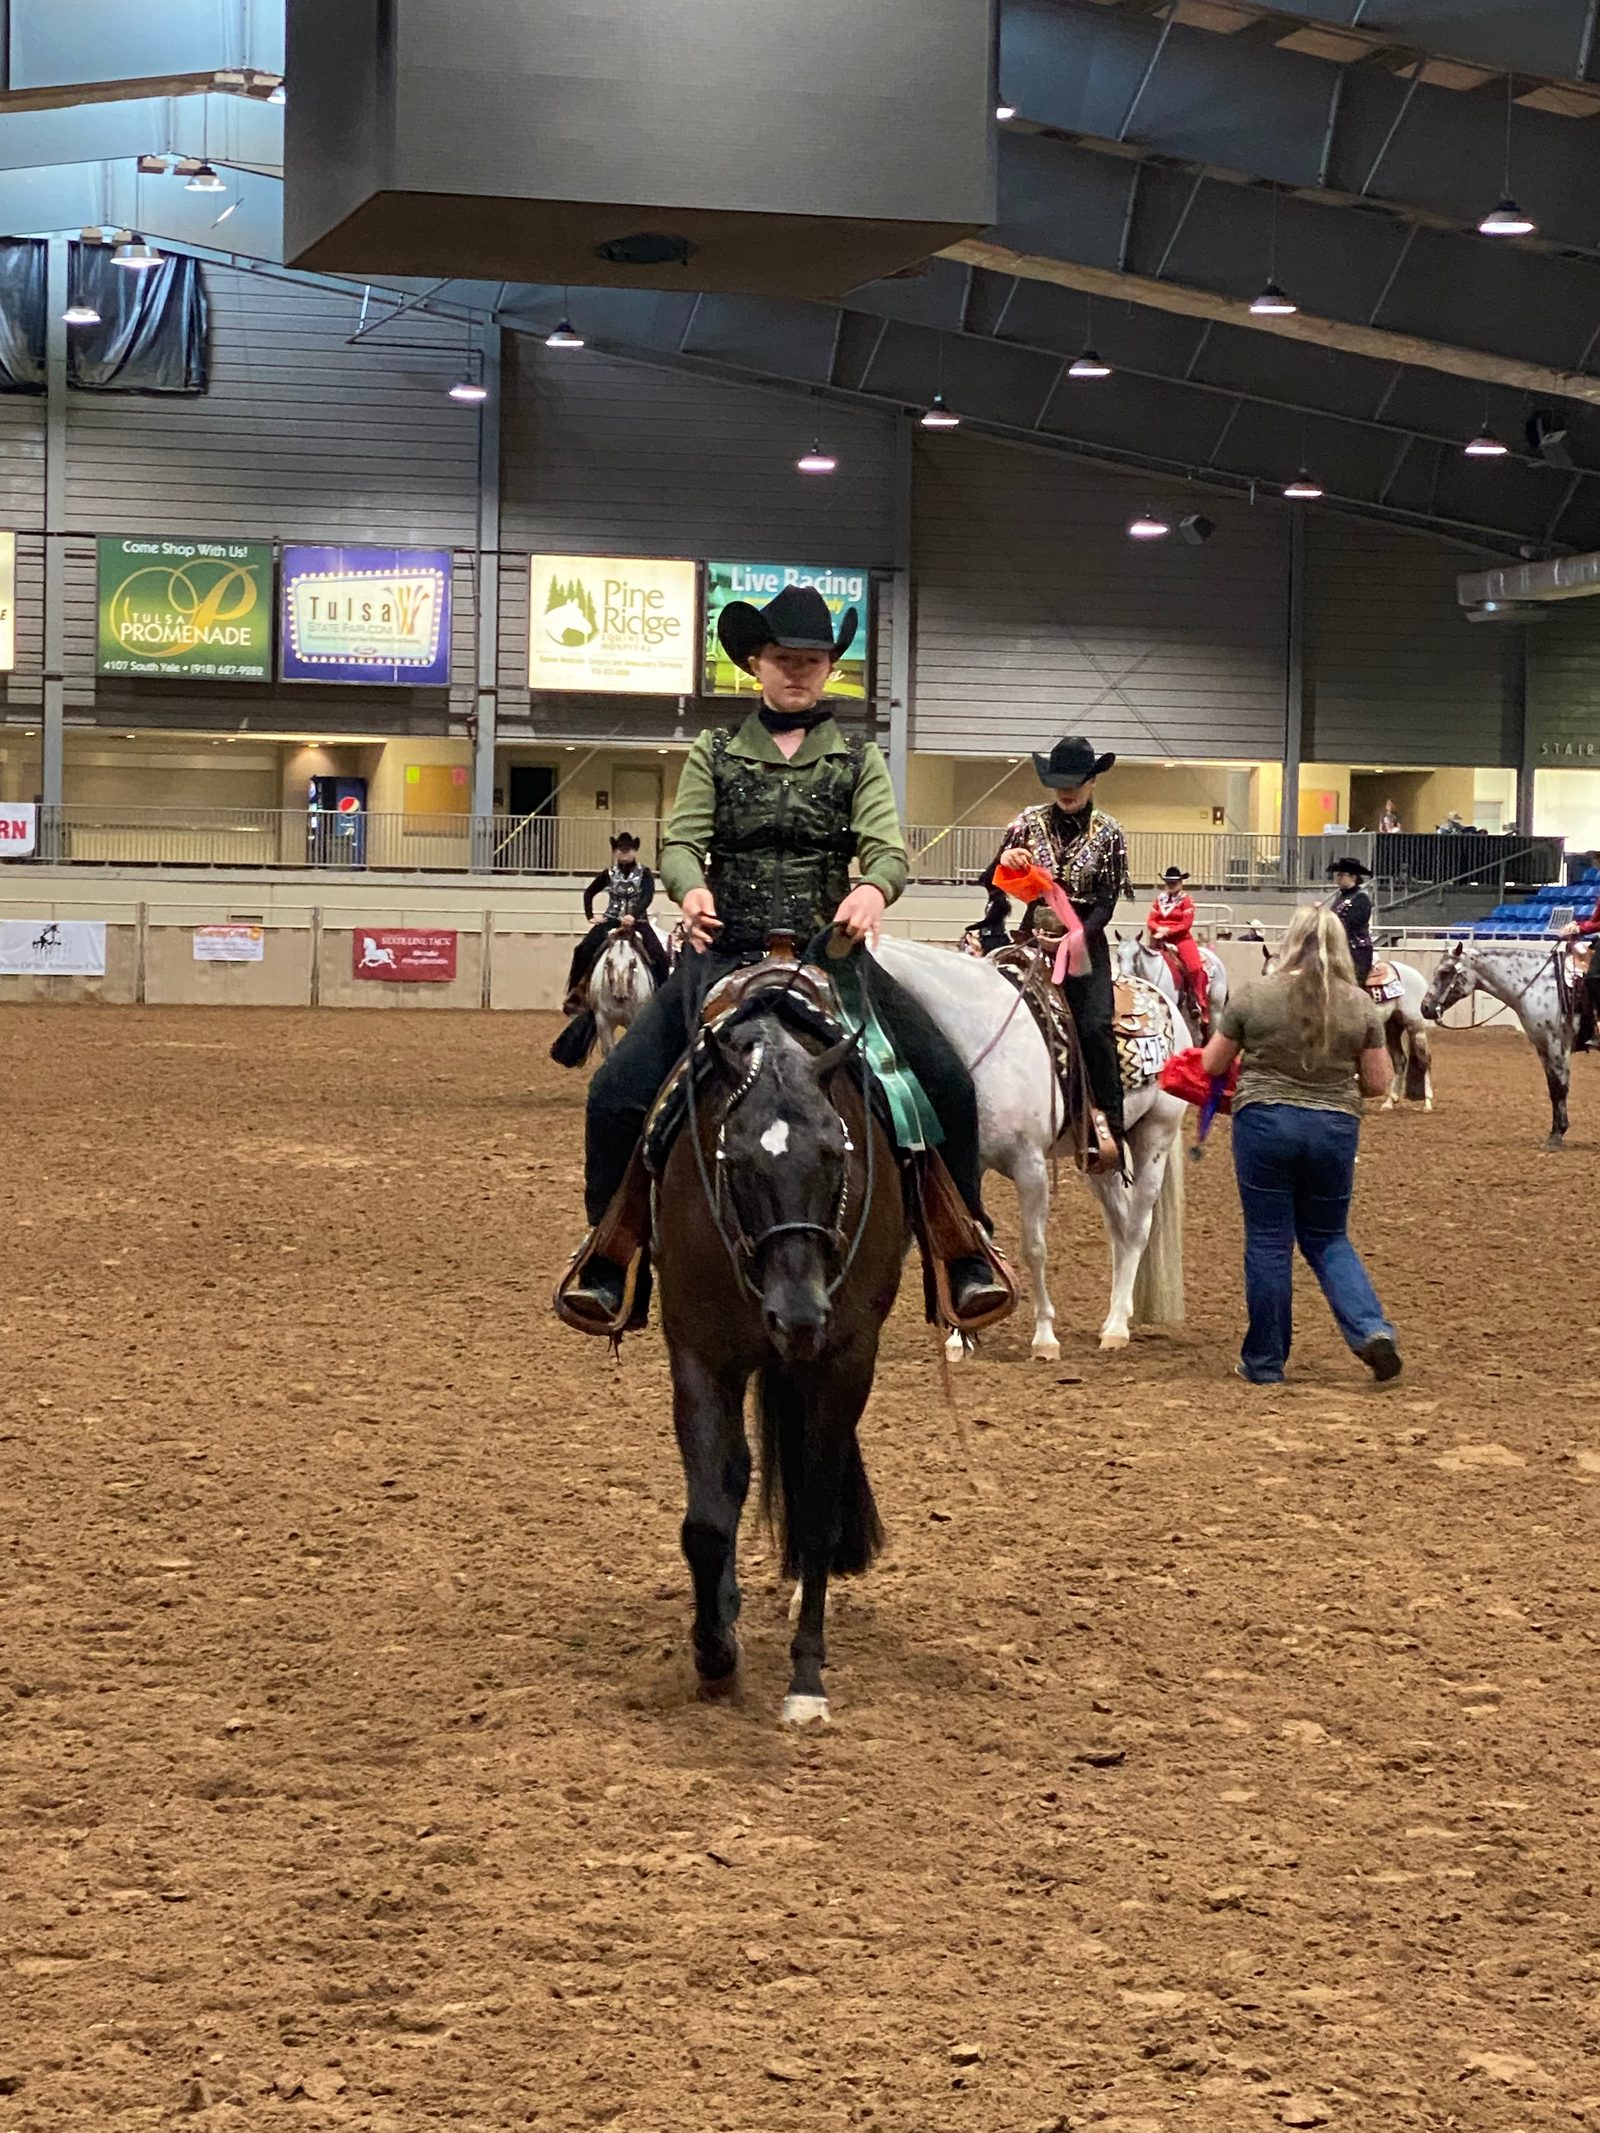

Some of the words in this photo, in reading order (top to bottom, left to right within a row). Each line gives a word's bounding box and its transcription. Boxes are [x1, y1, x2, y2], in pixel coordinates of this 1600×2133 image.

[122, 540, 159, 555] Come
[161, 542, 195, 557] Shop
[197, 544, 226, 557] With
[229, 545, 248, 558] Us!
[604, 579, 664, 609] Pine
[731, 566, 779, 593] Live
[783, 568, 863, 602] Racing
[132, 613, 186, 625] TULSA
[310, 596, 391, 622] Tulsa
[120, 622, 252, 646] PROMENADE
[603, 606, 681, 644] Ridge
[103, 660, 129, 670] 4107
[130, 661, 159, 671] South
[160, 662, 181, 673] Yale
[190, 663, 216, 675] (918)
[1541, 742, 1594, 756] STAIR
